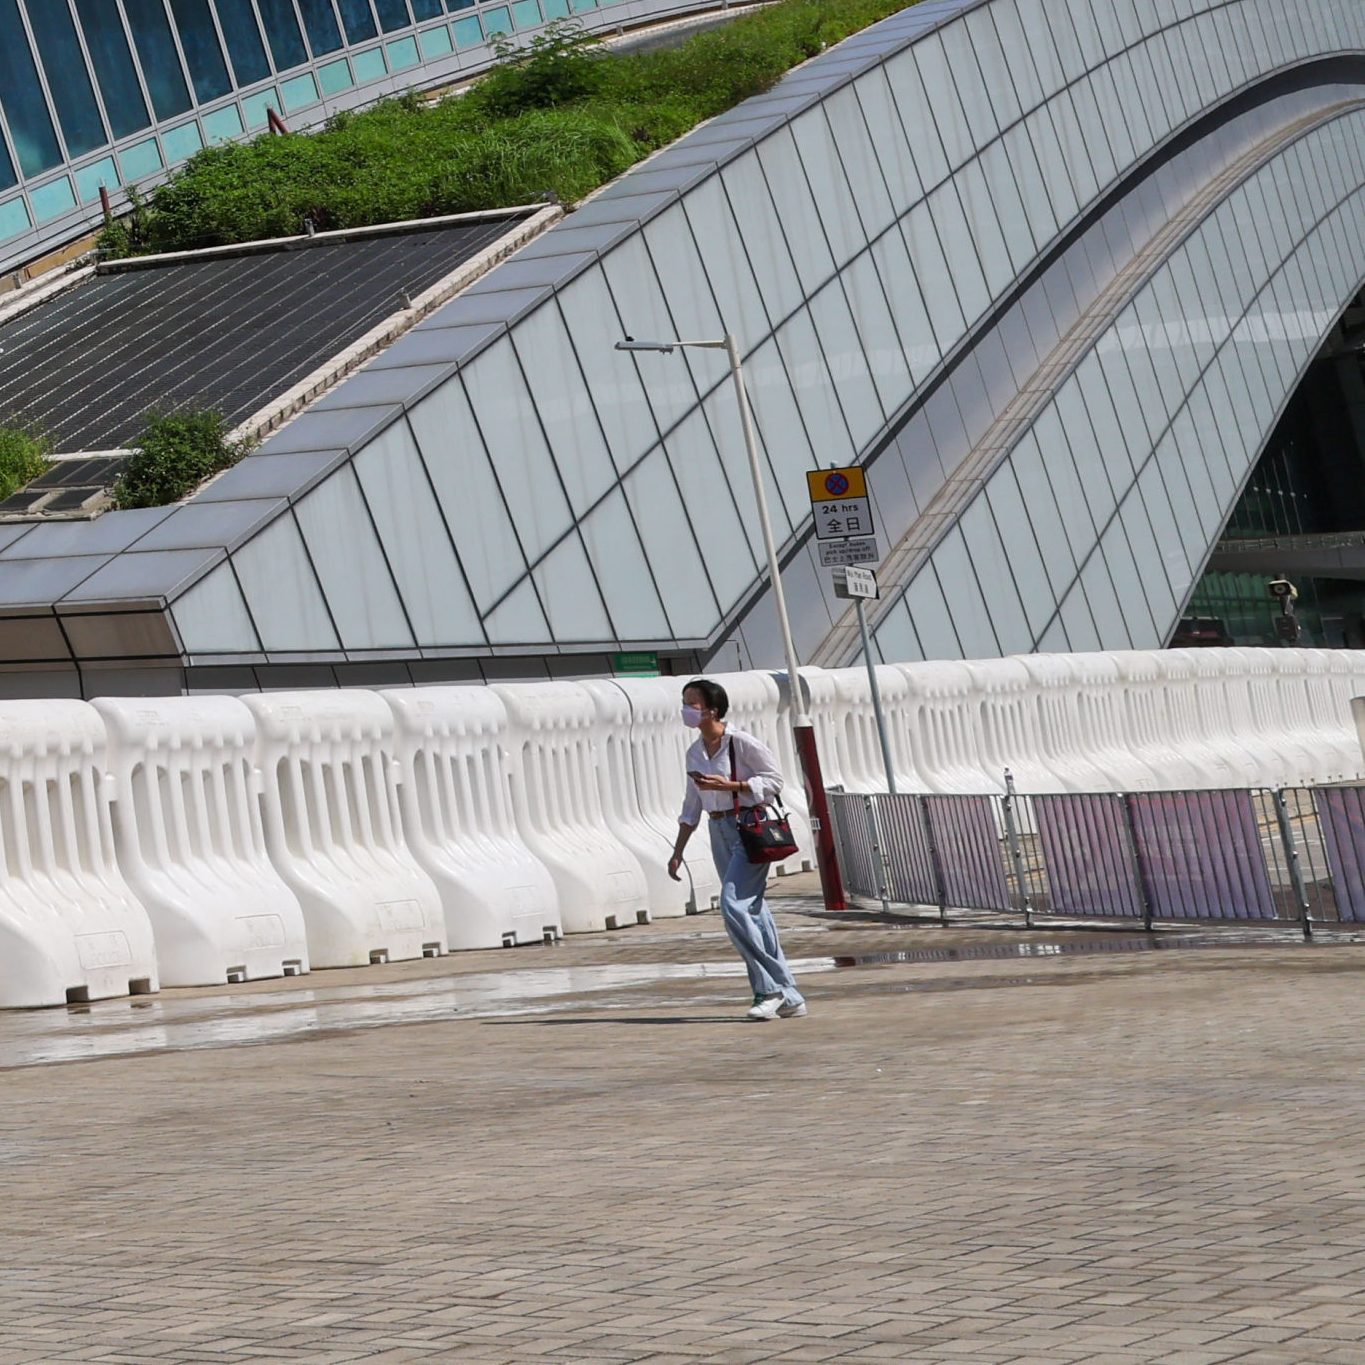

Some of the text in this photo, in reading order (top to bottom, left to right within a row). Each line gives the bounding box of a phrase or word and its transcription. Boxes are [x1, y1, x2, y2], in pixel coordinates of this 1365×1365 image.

[822, 504, 859, 514] 24 hrs
[827, 517, 861, 533] 全日
